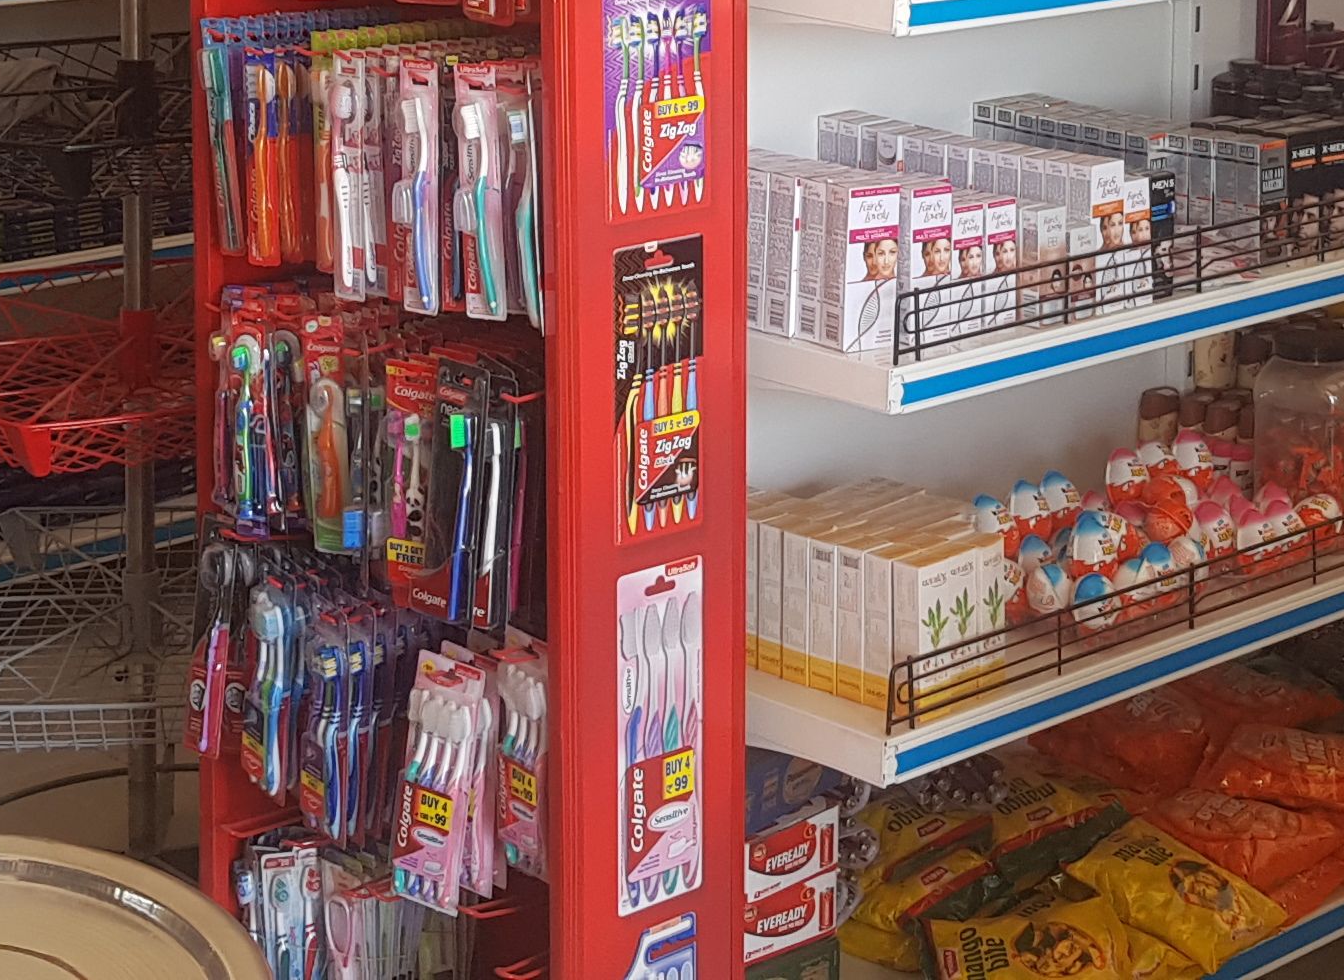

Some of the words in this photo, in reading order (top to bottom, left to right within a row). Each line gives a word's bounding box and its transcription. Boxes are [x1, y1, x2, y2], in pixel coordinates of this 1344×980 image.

[658, 105, 672, 116] BUY
[674, 103, 678, 112] 6
[642, 110, 654, 172] Colgate
[1292, 145, 1316, 159] X-MEN
[654, 422, 668, 433] BUY
[670, 420, 674, 429] 5
[638, 428, 648, 490] Colgate
[396, 552, 423, 564] FREE
[668, 562, 695, 575] UltraSoft
[665, 761, 682, 776] BUY
[684, 756, 691, 768] 4
[631, 769, 645, 852] Colgate
[654, 805, 689, 825] Sensitive
[766, 842, 810, 872] EVEREADY
[757, 904, 807, 934] EVEREADY
